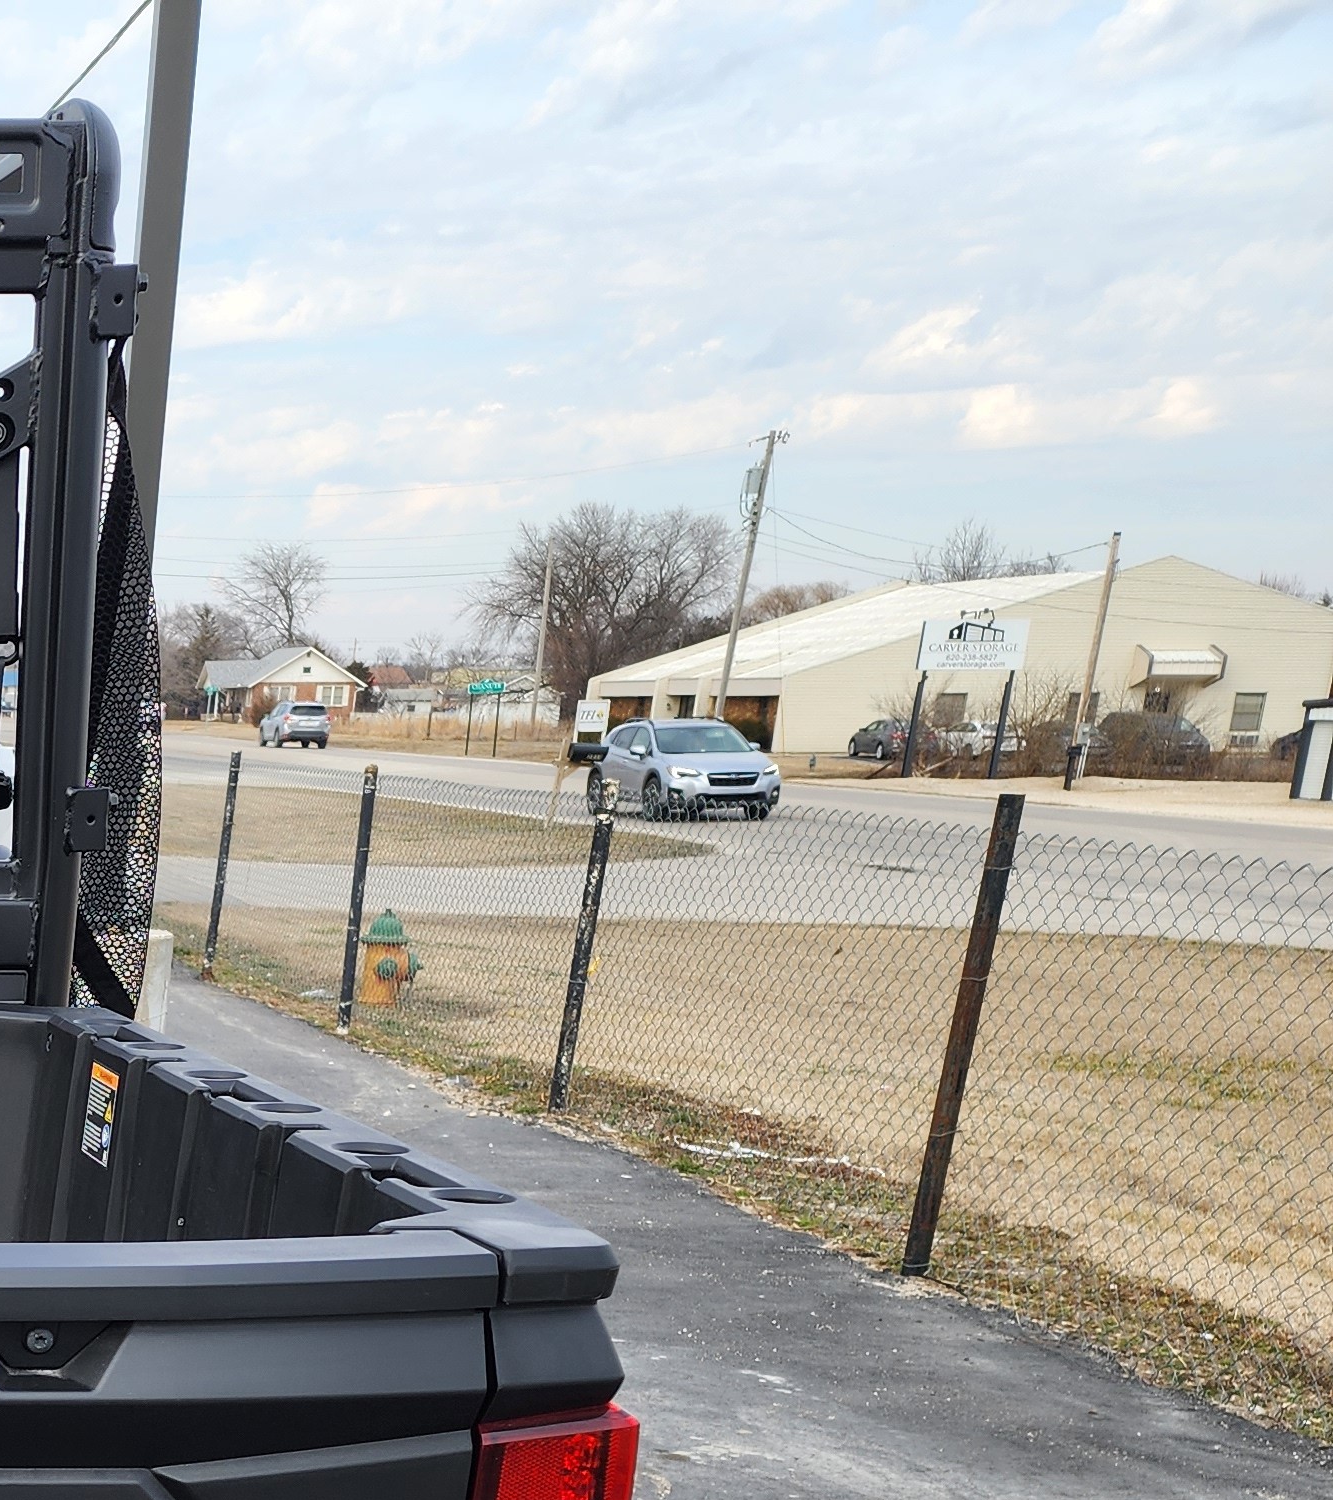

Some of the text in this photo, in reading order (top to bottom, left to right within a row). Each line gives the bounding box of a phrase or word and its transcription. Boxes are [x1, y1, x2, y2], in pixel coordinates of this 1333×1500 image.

[928, 642, 1018, 652] CARVER STORAGE
[580, 710, 596, 720] TFI
